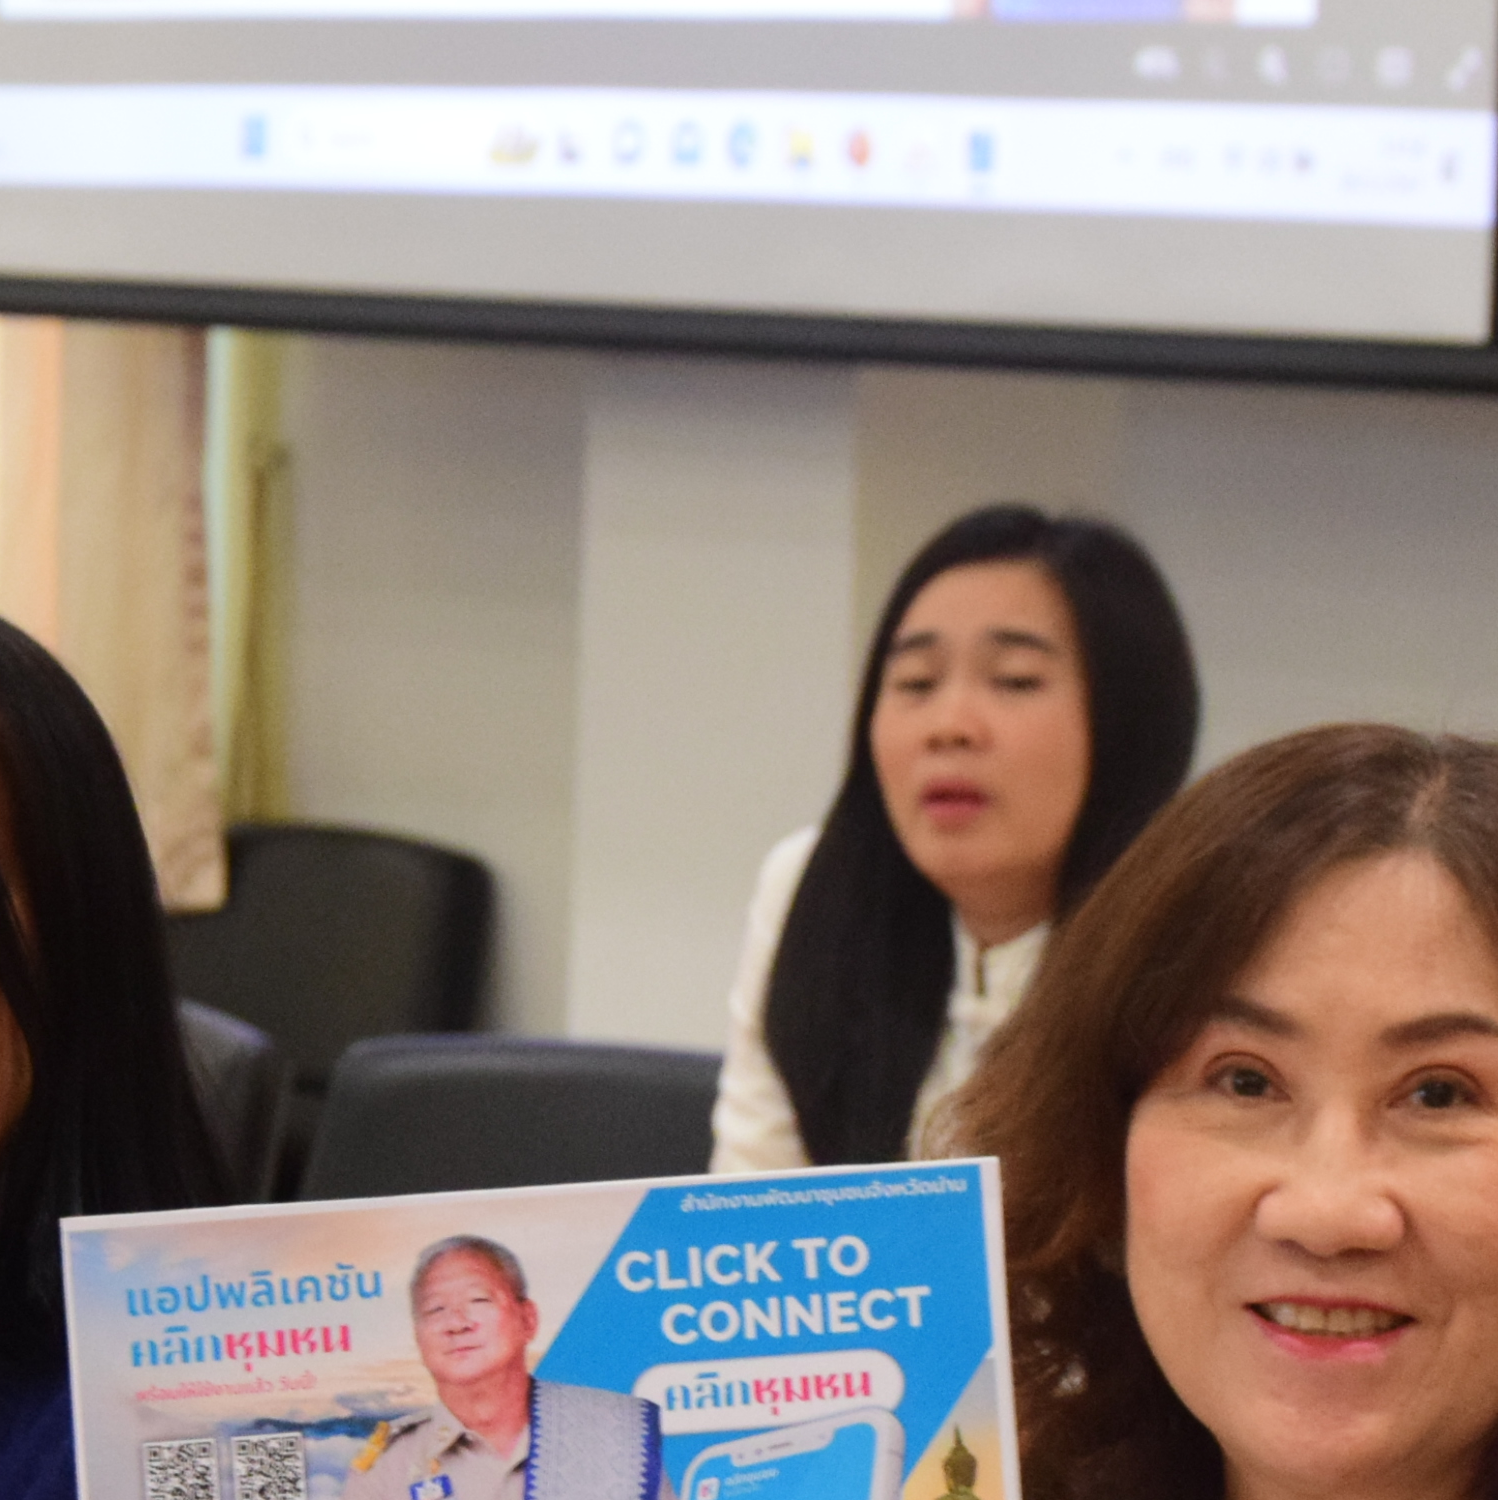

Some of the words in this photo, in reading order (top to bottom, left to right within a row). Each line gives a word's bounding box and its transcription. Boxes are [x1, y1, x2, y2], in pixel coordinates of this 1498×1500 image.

[127, 1263, 383, 1317] แอปพลิเคชัน
[615, 1241, 781, 1293] CLICK
[791, 1235, 870, 1280] TO
[661, 1285, 931, 1345] CONNECT
[131, 1324, 352, 1373] คลิกชุมชน
[666, 1371, 873, 1416] คลิกชุมชน
